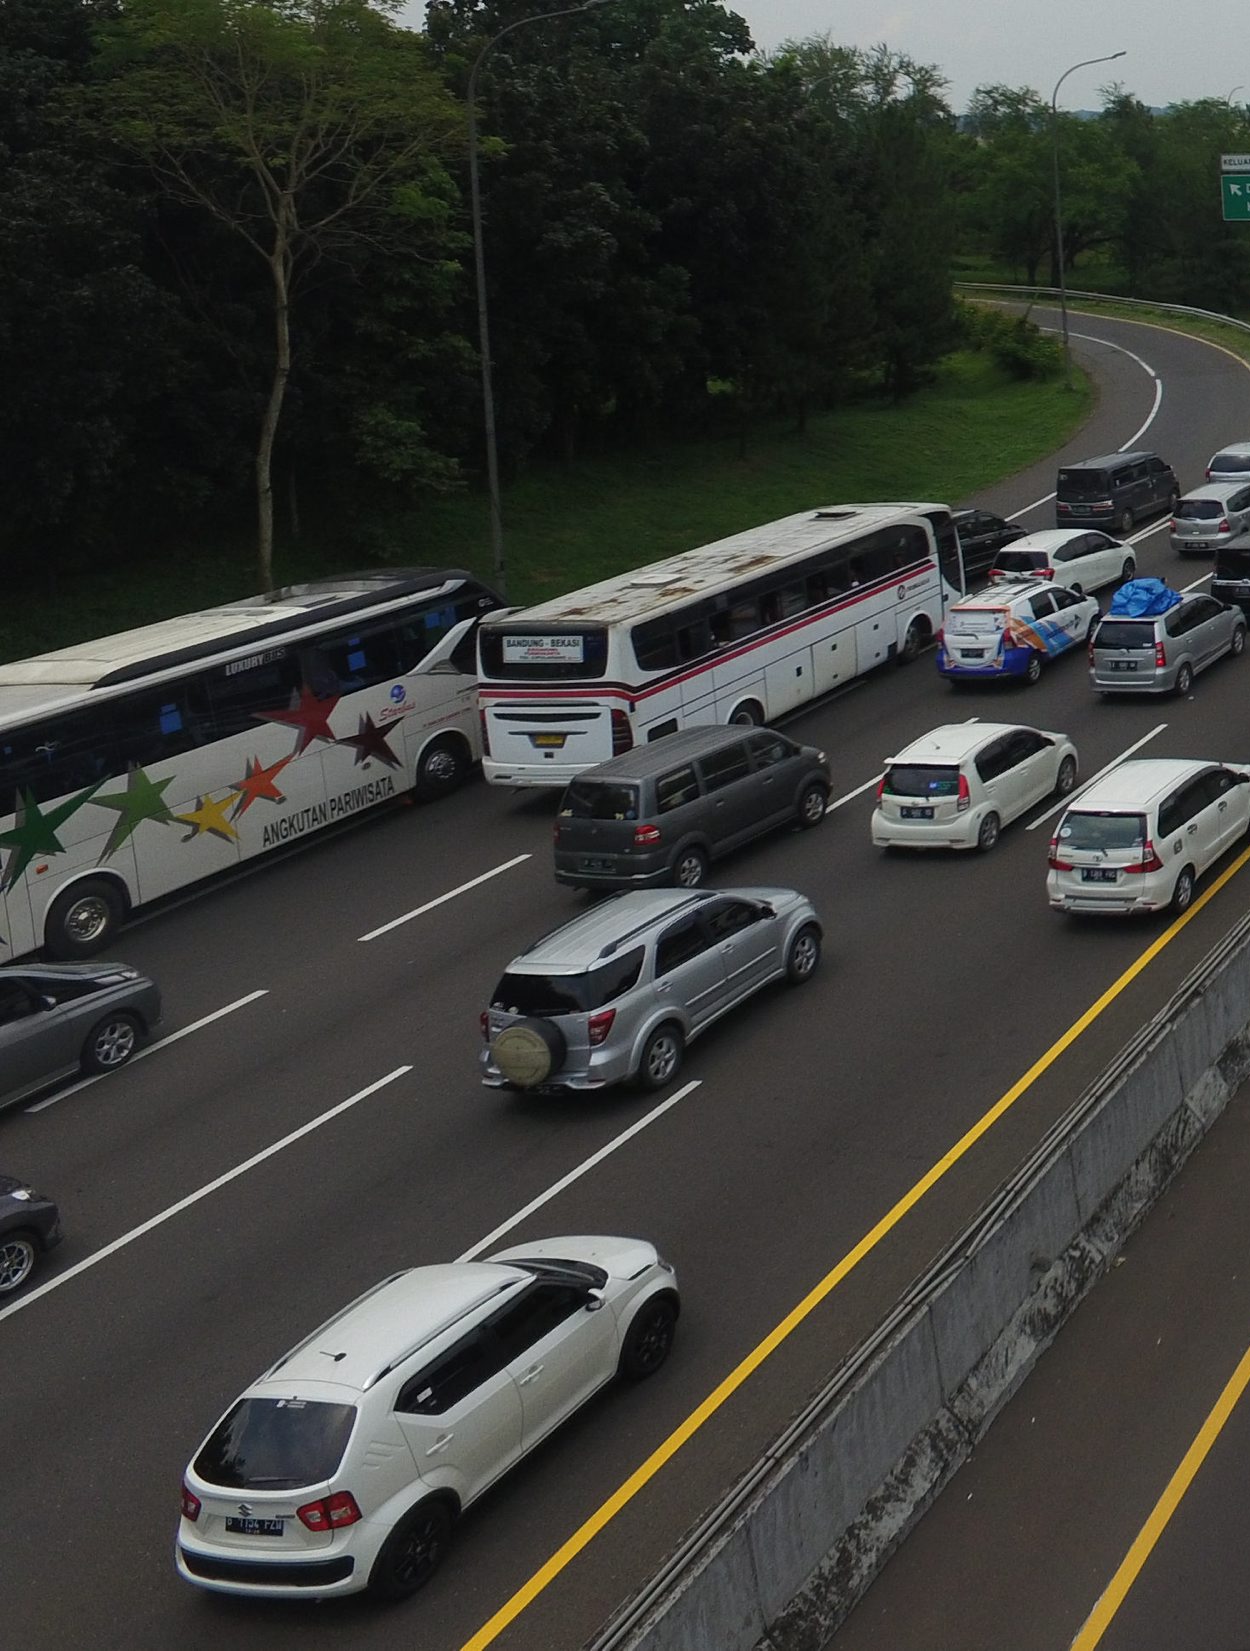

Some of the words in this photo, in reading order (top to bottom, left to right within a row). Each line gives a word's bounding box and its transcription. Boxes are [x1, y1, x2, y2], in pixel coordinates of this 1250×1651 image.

[506, 639, 544, 648] BANDUNG
[551, 639, 580, 648] BEKASI
[262, 801, 328, 848] ANGKUTAN
[328, 775, 395, 820] PARIWISATA
